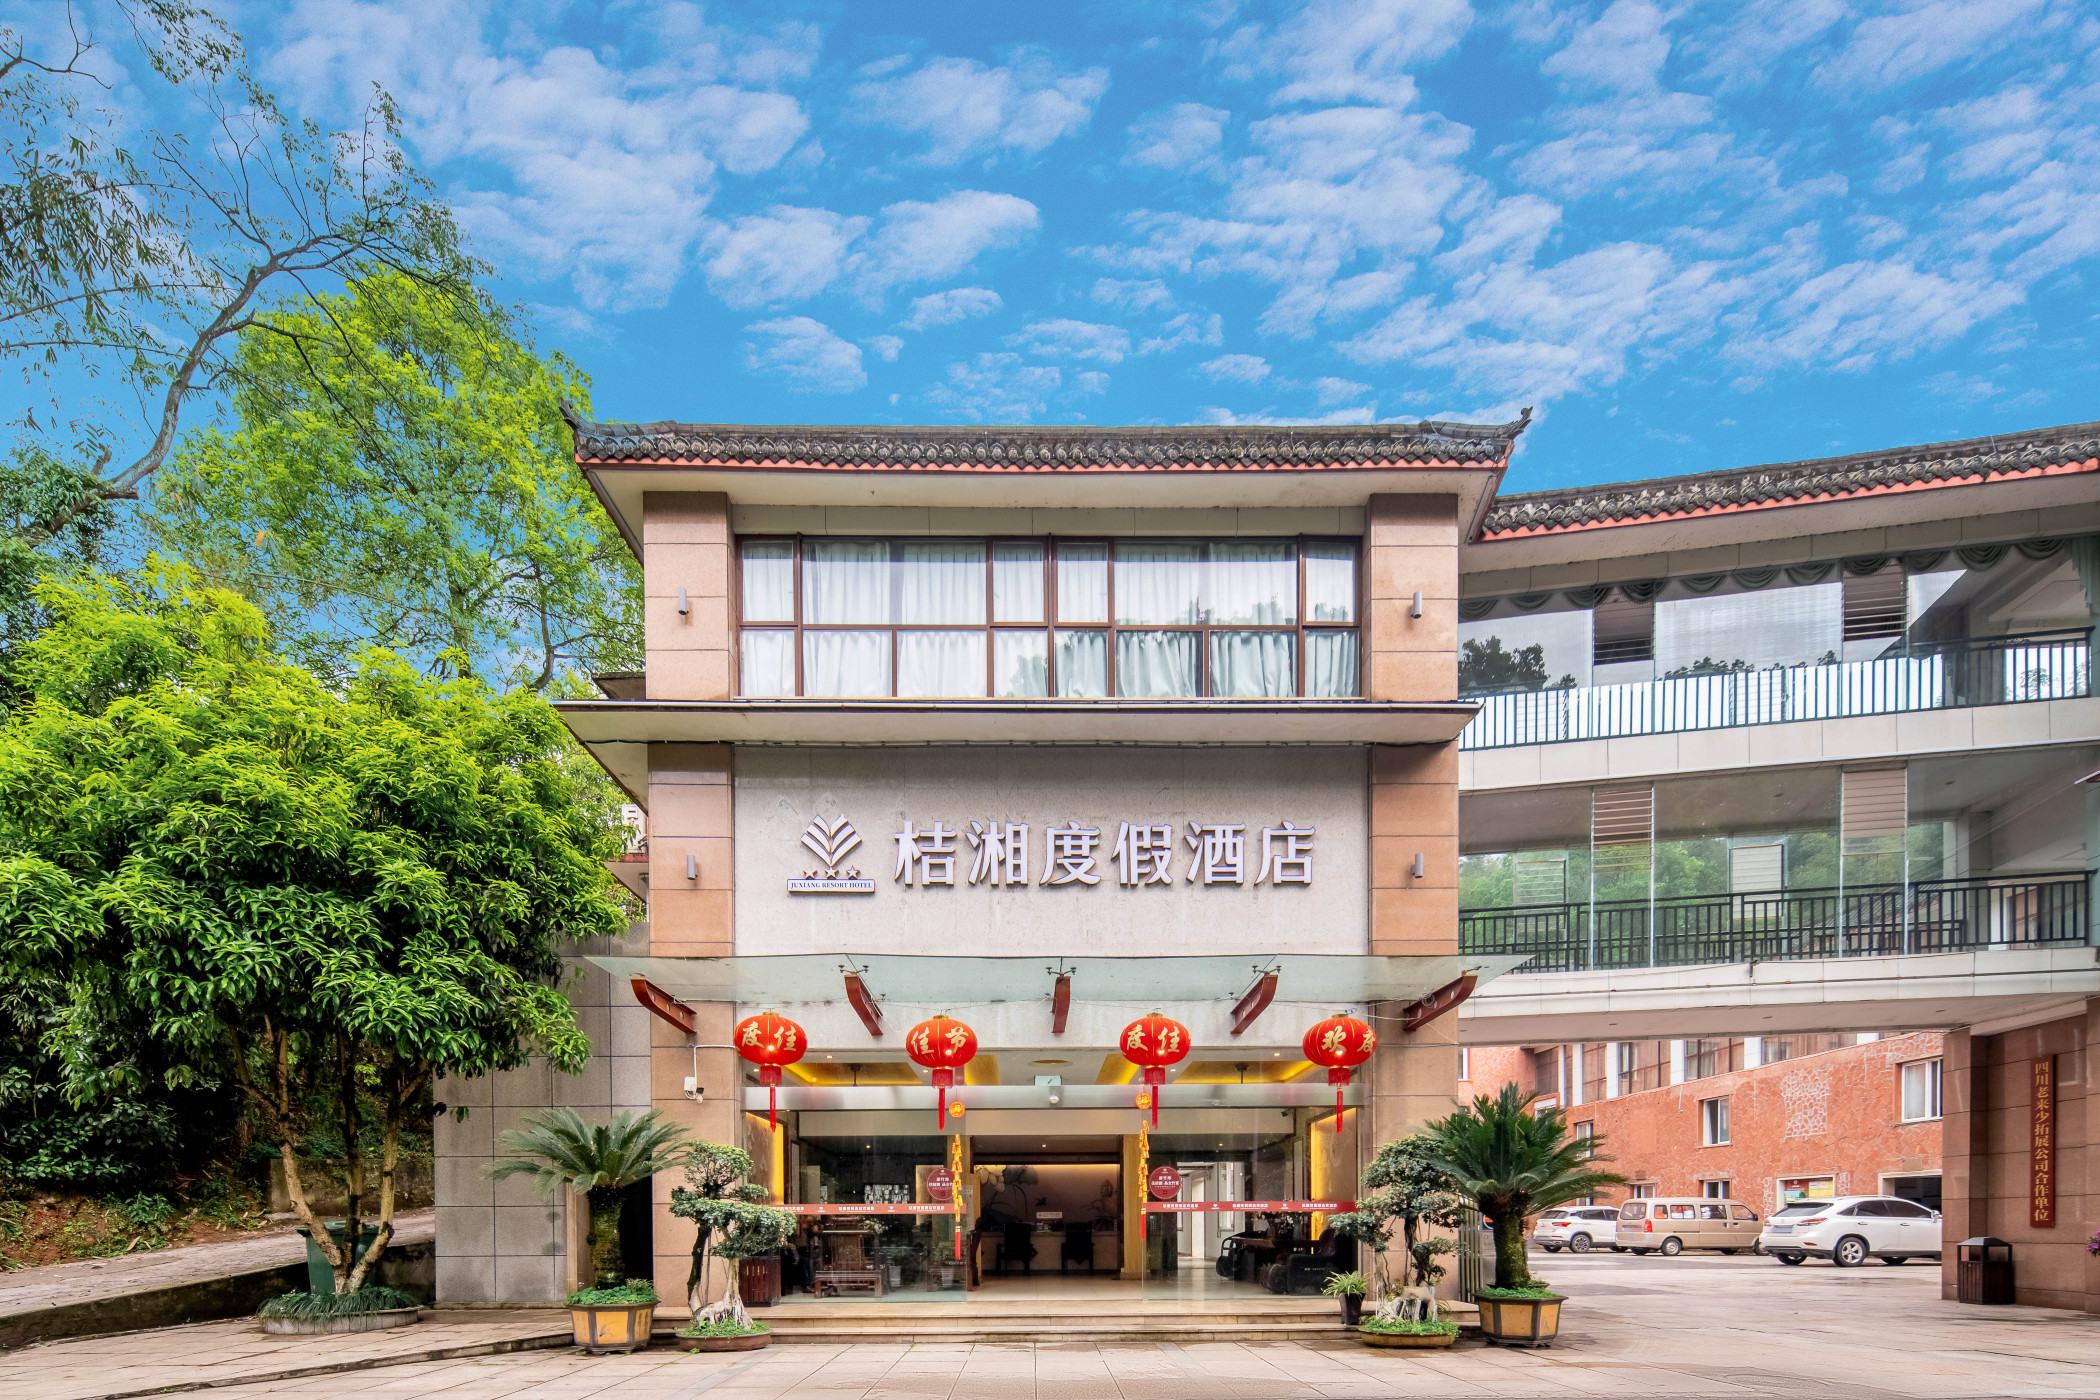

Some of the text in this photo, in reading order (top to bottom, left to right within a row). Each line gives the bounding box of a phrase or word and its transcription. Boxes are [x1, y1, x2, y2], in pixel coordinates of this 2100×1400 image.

[894, 820, 1316, 886] 桔湘度假酒店
[2034, 1061, 2049, 1222] 四川老来少拓展公司合作单位
